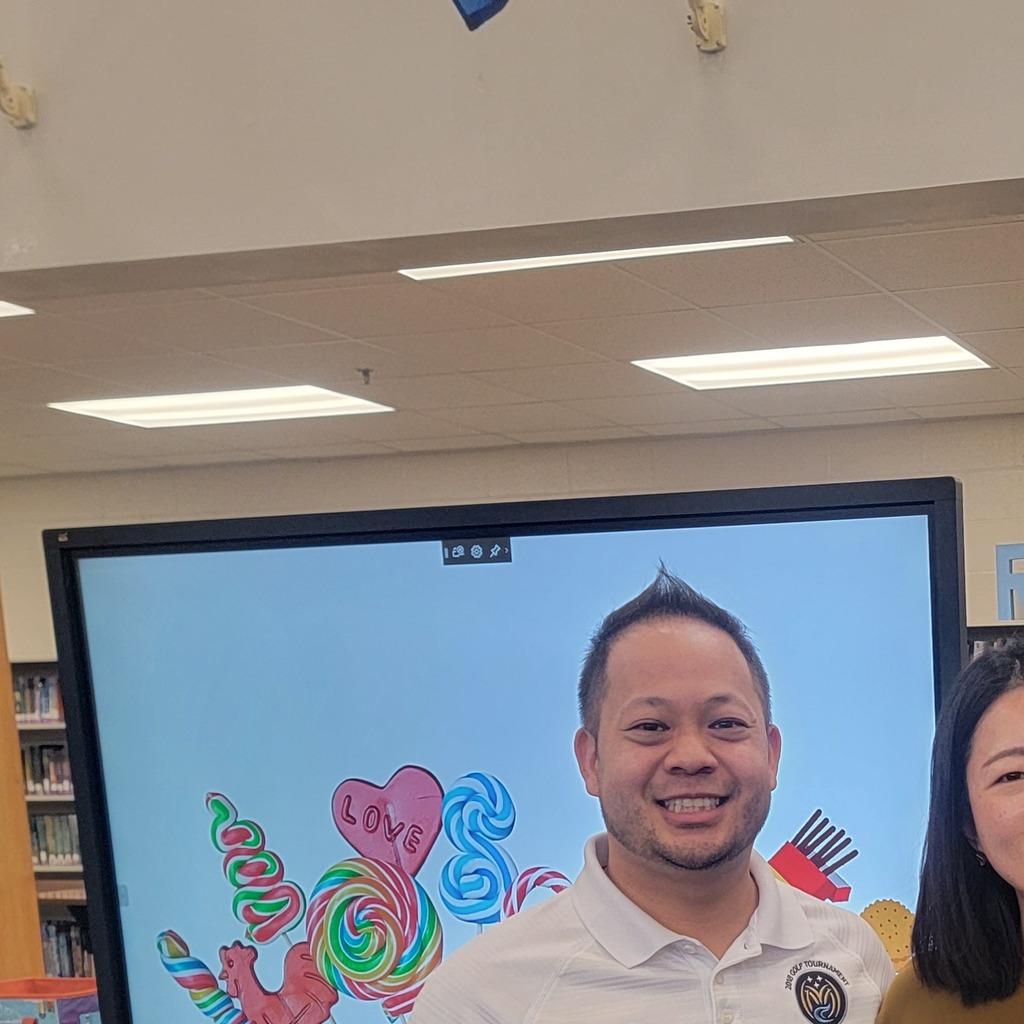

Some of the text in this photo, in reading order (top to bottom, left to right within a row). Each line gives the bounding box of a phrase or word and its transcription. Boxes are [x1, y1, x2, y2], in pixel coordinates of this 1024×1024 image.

[341, 794, 424, 854] LOVE
[789, 963, 804, 977] GOLF
[803, 960, 851, 987] TOURNAMENT
